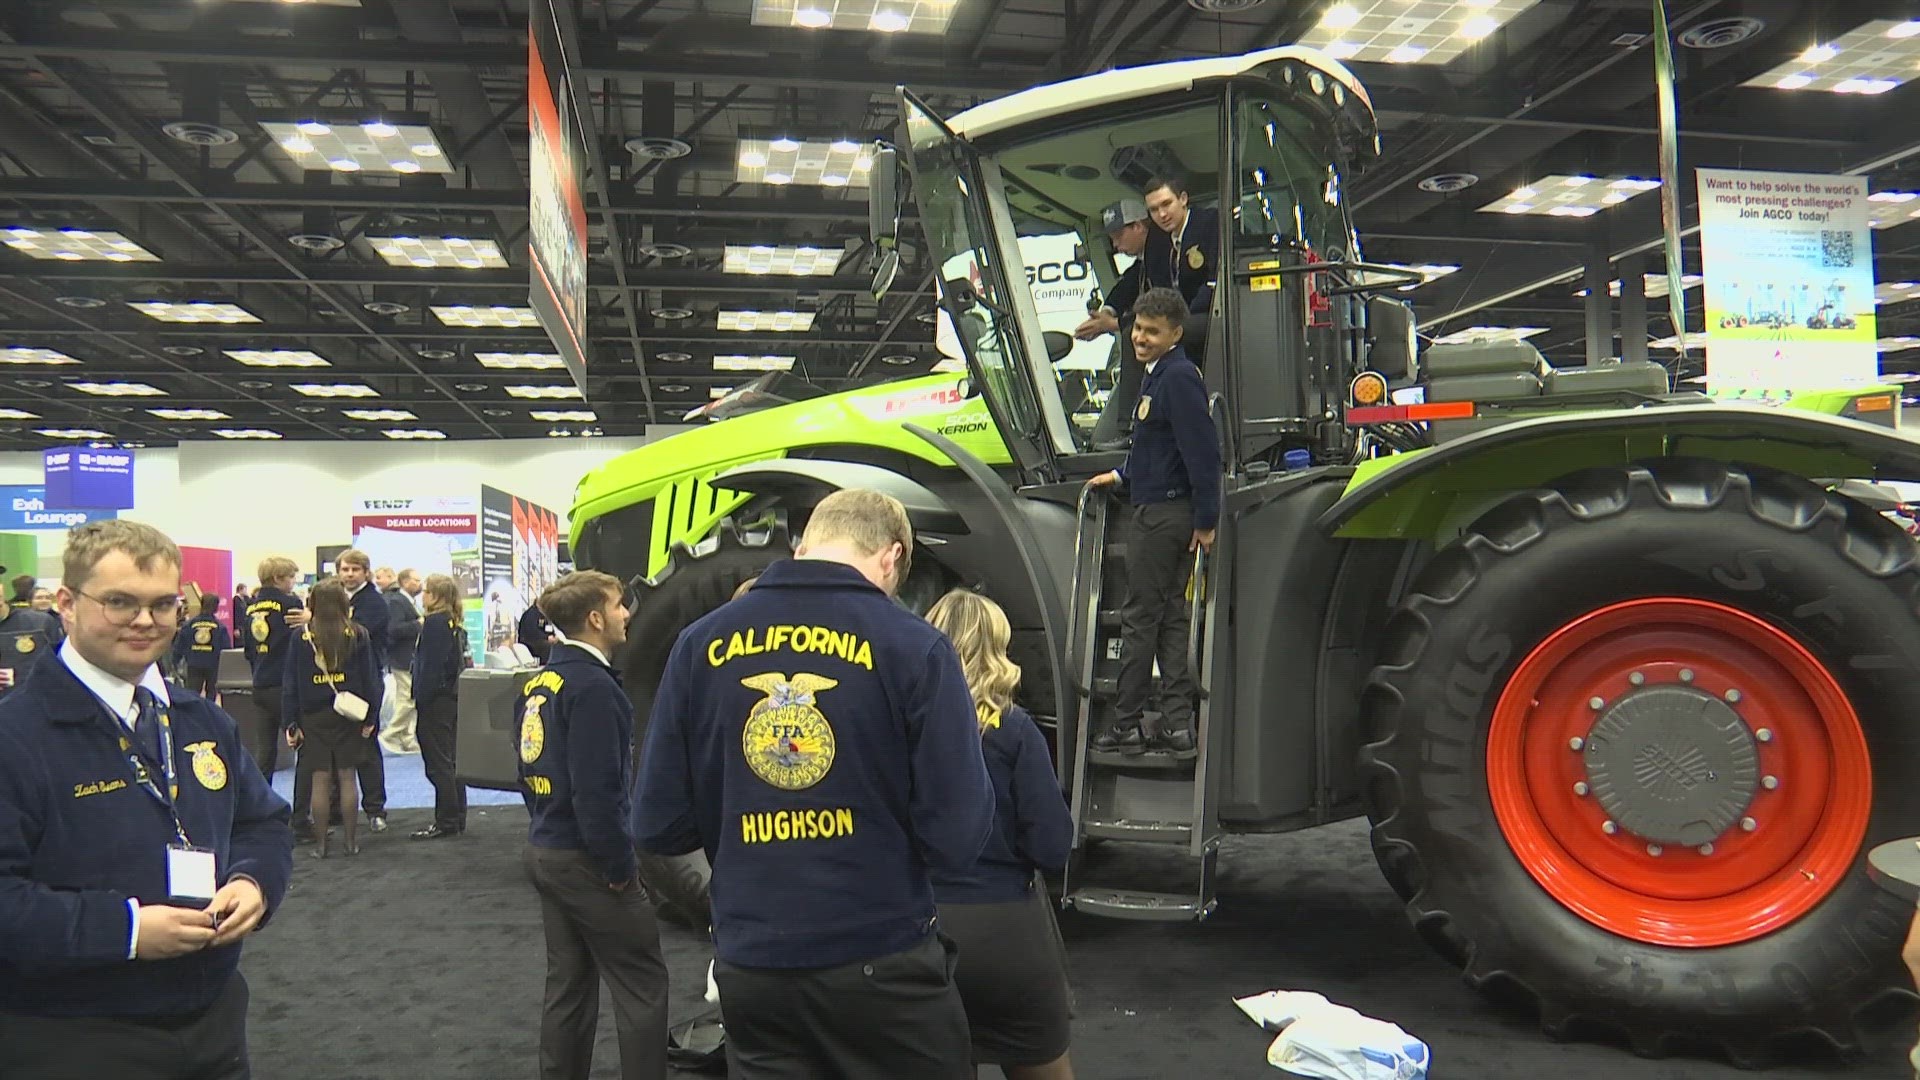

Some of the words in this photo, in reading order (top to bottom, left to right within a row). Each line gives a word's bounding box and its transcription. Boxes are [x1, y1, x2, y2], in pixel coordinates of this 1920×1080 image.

[1706, 178, 1732, 190] Want
[1736, 180, 1747, 190] to
[1750, 180, 1772, 193] help
[1775, 182, 1800, 192] solve
[1804, 183, 1820, 194] the
[1824, 185, 1859, 196] world's
[1715, 194, 1741, 204] most
[1745, 195, 1788, 208] pressing
[1791, 197, 1851, 210] challenges?
[1739, 207, 1759, 219] Join
[1763, 209, 1792, 220] AGCO
[1799, 210, 1829, 223] today!
[1034, 287, 1086, 300] Company
[936, 422, 988, 436] XERION
[363, 499, 414, 510] FENDT
[24, 511, 88, 527] Lounge
[386, 518, 421, 528] DEALER
[422, 518, 472, 527] LOCATIONS
[707, 624, 874, 671] CALIFORNIA
[771, 724, 805, 739] FFA
[740, 807, 854, 845] HUGHSON
